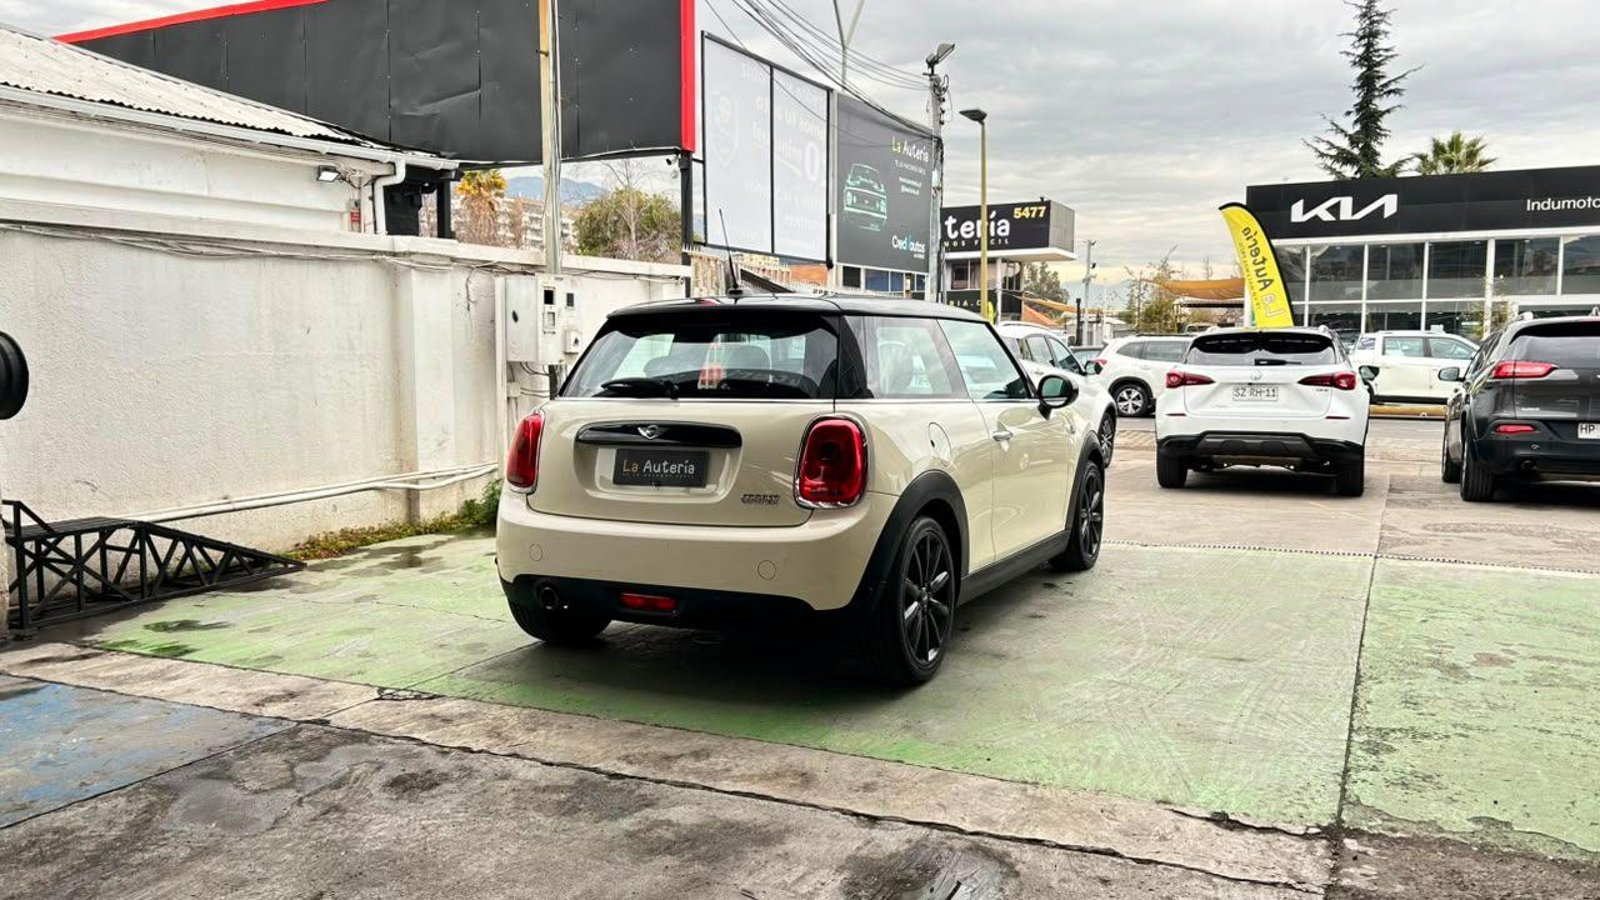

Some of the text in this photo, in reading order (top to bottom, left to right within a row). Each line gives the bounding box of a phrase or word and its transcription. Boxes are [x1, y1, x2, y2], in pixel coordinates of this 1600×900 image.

[1013, 205, 1047, 218] 5477
[1291, 194, 1398, 222] KIA
[623, 459, 696, 474] La Autería
